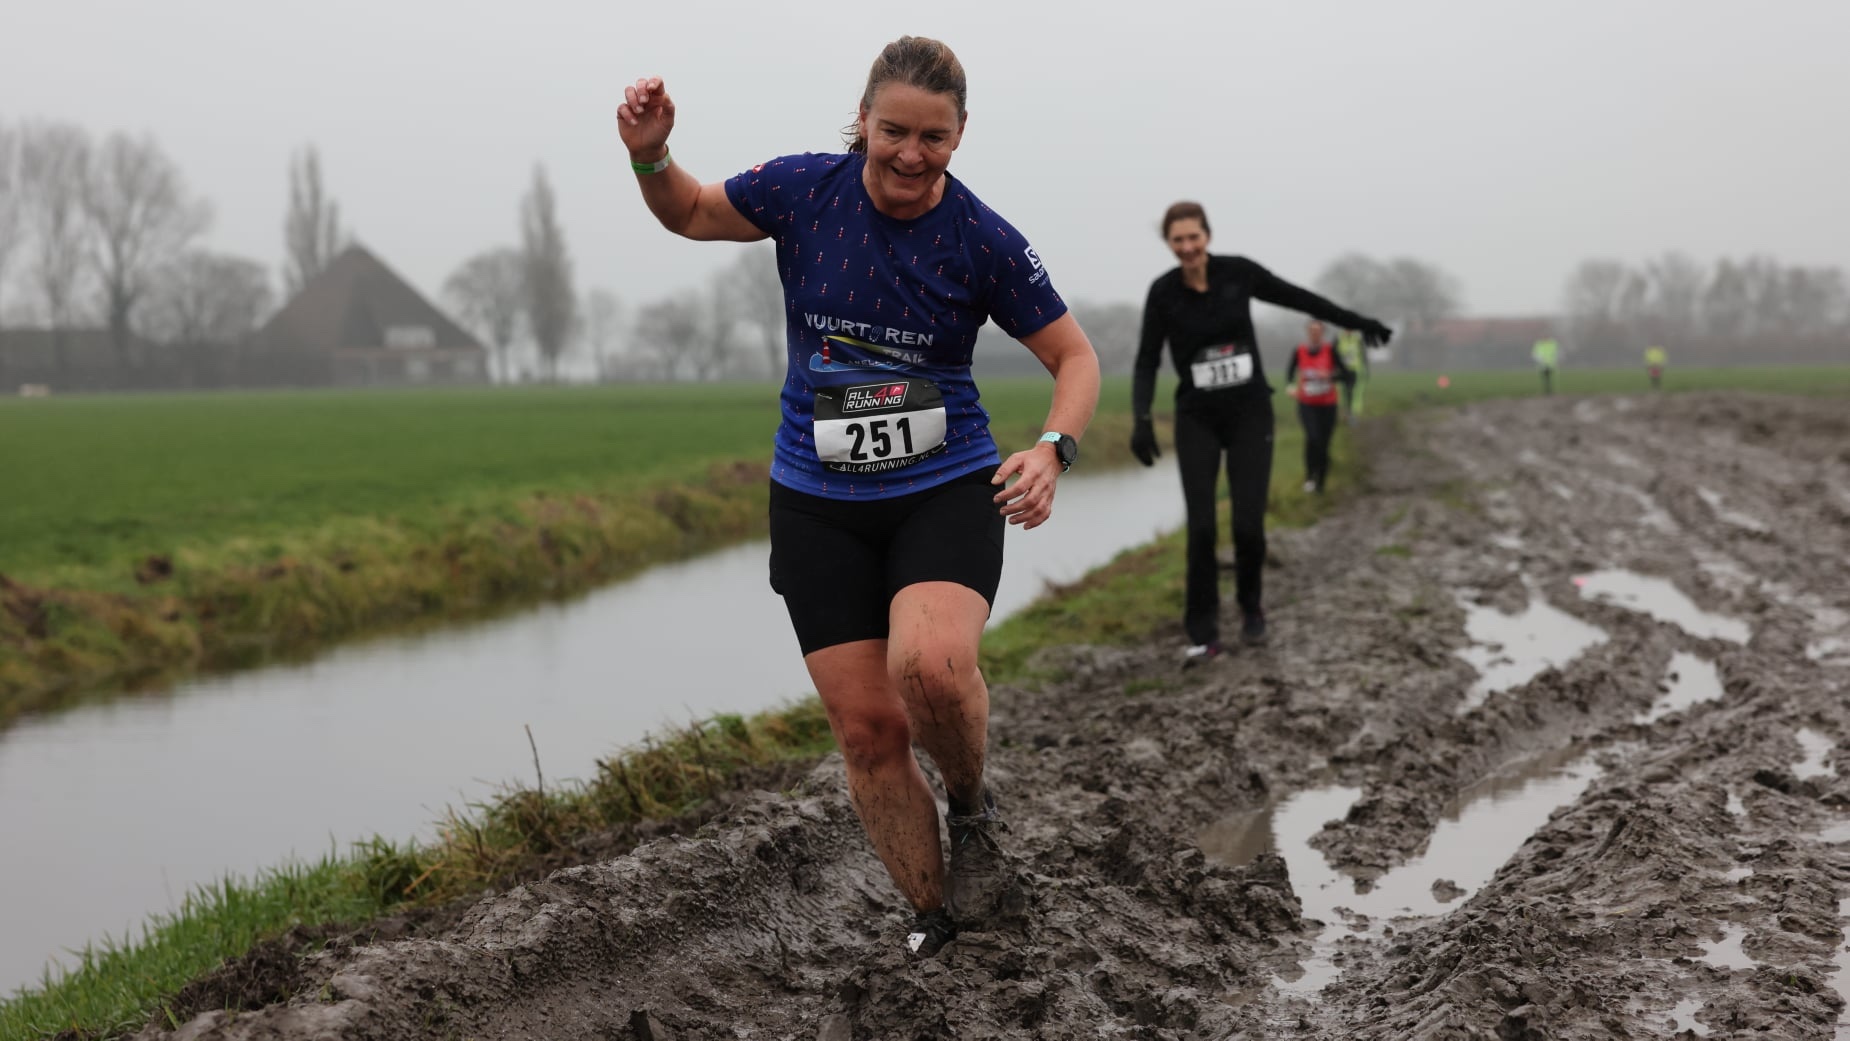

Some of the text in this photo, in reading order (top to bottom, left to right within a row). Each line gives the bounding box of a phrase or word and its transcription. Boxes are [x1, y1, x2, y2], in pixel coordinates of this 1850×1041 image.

[804, 312, 934, 346] VUURTOREN
[846, 395, 902, 409] RUNNING
[848, 390, 873, 401] ALL
[845, 417, 914, 461] 251
[840, 453, 929, 472] ALL4RUNNING.NL
